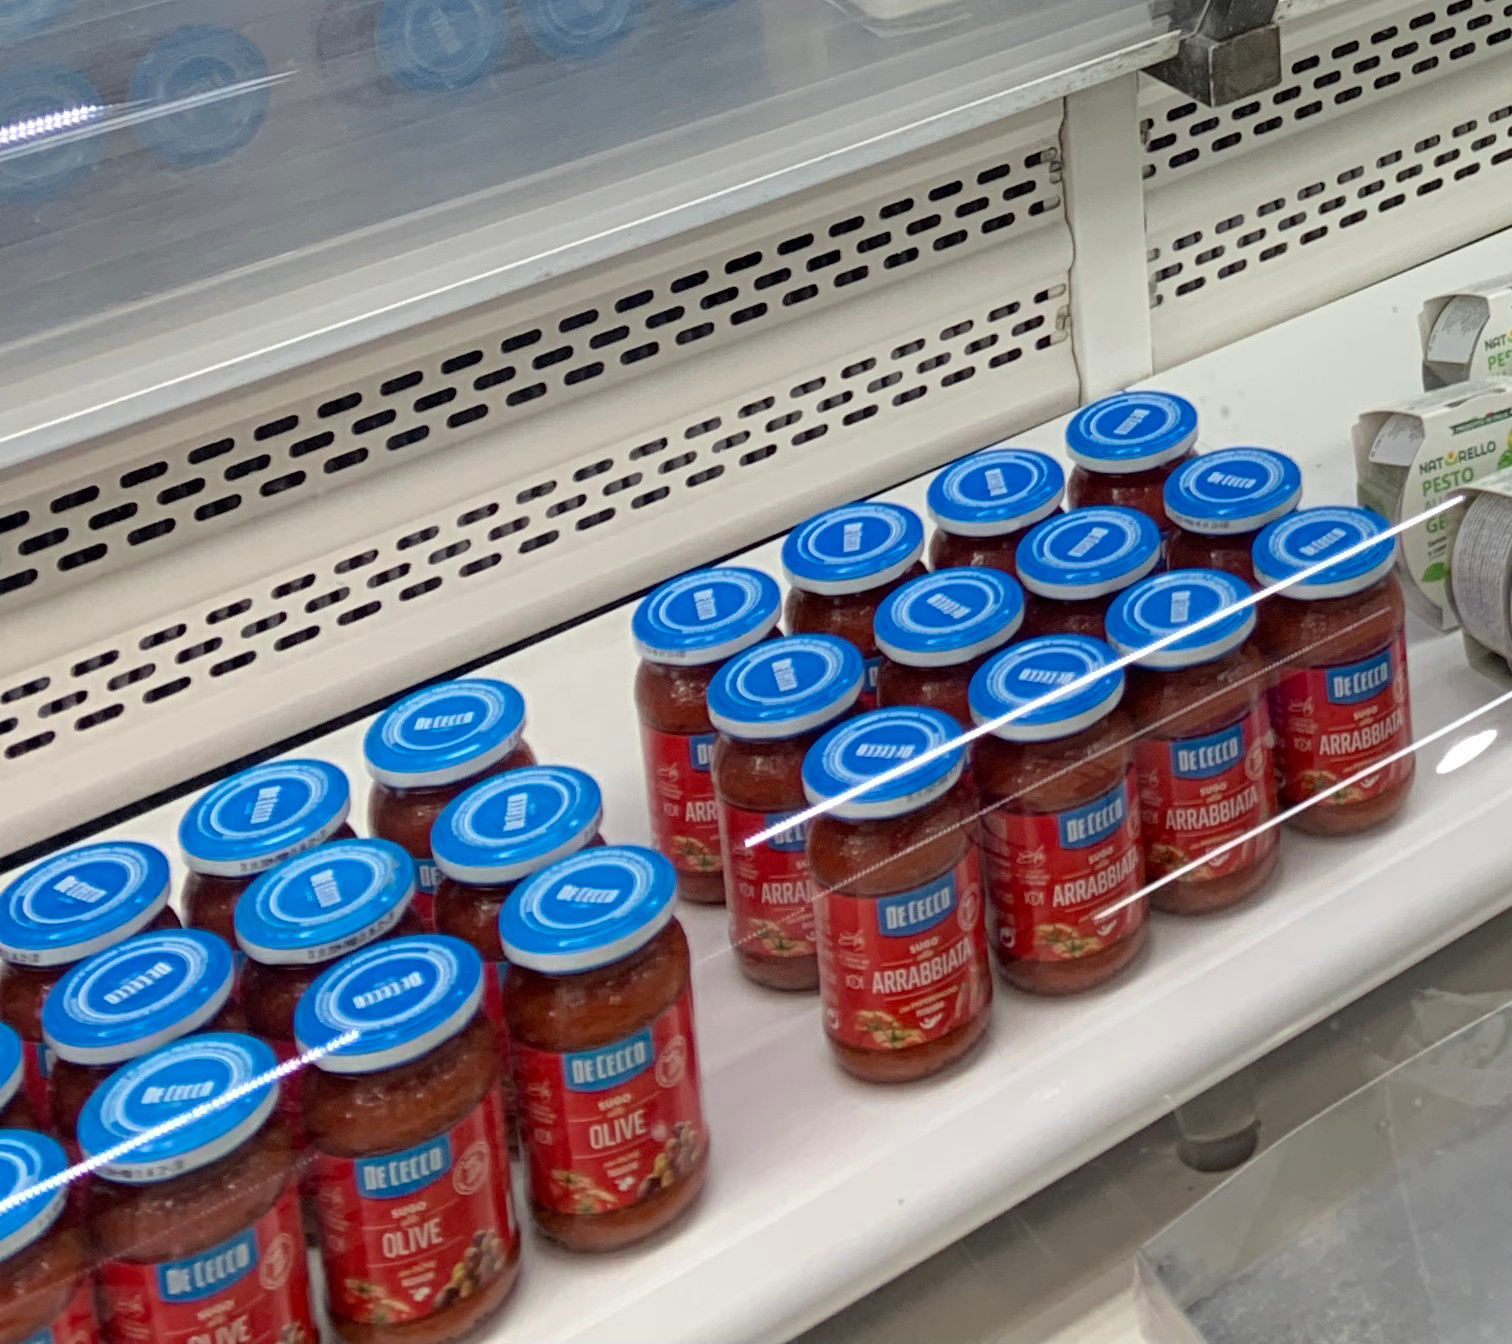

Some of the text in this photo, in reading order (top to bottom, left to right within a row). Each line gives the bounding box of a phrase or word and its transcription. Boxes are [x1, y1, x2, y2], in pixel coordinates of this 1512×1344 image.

[1422, 467, 1475, 497] PESTO
[1353, 662, 1389, 695] CECCO
[1319, 708, 1404, 756] ARRABBIATA
[1197, 736, 1239, 769] CECCO
[1087, 797, 1123, 837] CECCO
[1165, 785, 1258, 831] ARRABBIATA
[1053, 846, 1139, 908] ARRABBIATA
[908, 887, 952, 927] CECCO
[872, 936, 973, 995] ARRABBIATA
[909, 936, 939, 955] SUGO
[596, 1041, 645, 1081] CECCO
[589, 1110, 646, 1151] OLIVE
[388, 1146, 443, 1187] CECCO
[391, 1200, 426, 1220] SUGO
[382, 1217, 443, 1260] OLIVE
[194, 1243, 248, 1288] CECCO
